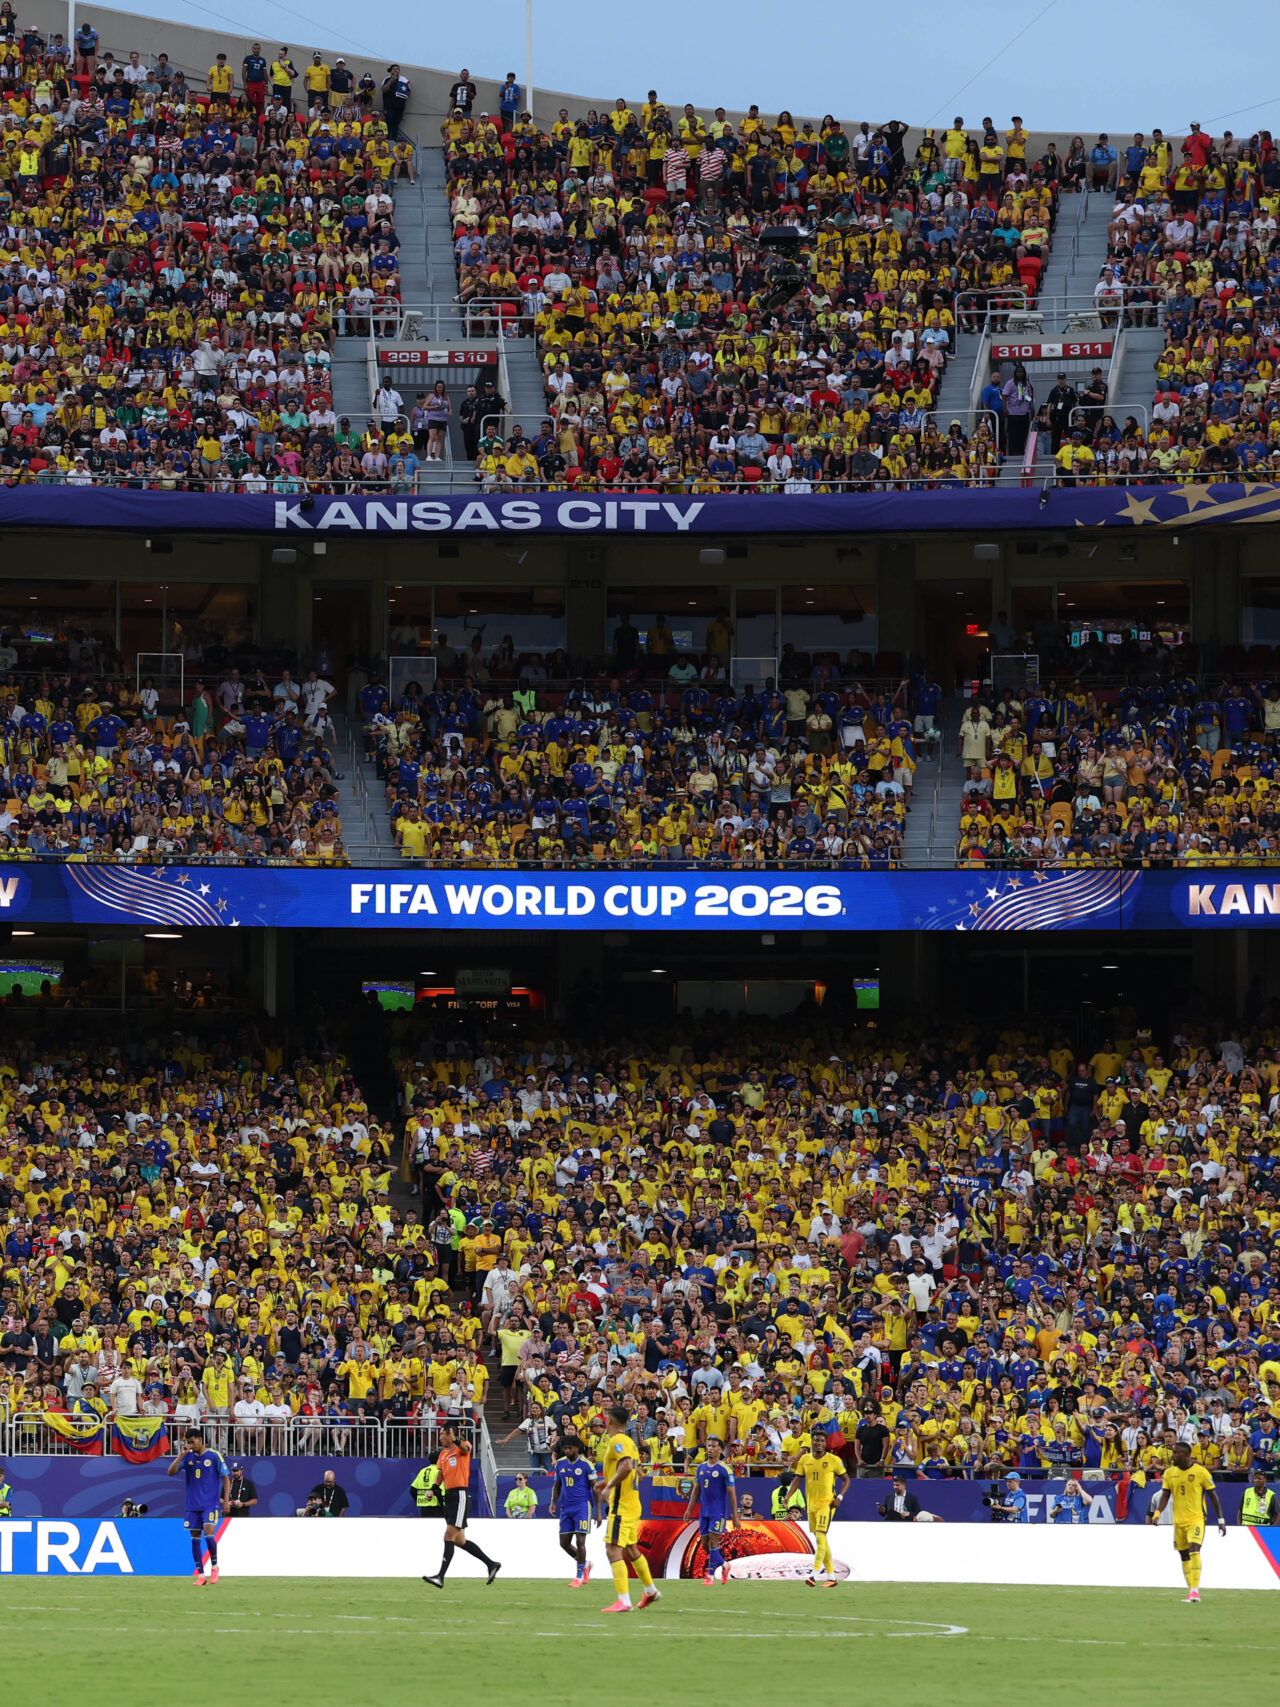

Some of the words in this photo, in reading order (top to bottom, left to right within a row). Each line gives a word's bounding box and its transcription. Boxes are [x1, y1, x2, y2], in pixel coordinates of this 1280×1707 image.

[998, 346, 1033, 357] 310
[1070, 344, 1102, 355] 311
[388, 352, 420, 362] 309
[454, 352, 488, 362] 310
[274, 500, 542, 530] KANSAS
[557, 500, 706, 530] CITY
[350, 884, 438, 914] FIFA
[444, 884, 596, 916] WORLD
[603, 884, 687, 916] CUP
[694, 884, 842, 916] 2026
[195, 1468, 201, 1478] 8
[812, 1471, 818, 1480] 11
[564, 1476, 574, 1487] 10
[704, 1478, 709, 1488] 3
[1026, 1494, 1116, 1524] FIA
[209, 1512, 214, 1521] 8
[819, 1515, 826, 1524] 11
[580, 1520, 587, 1530] 10
[714, 1520, 720, 1530] 3
[1195, 1526, 1200, 1536] 9
